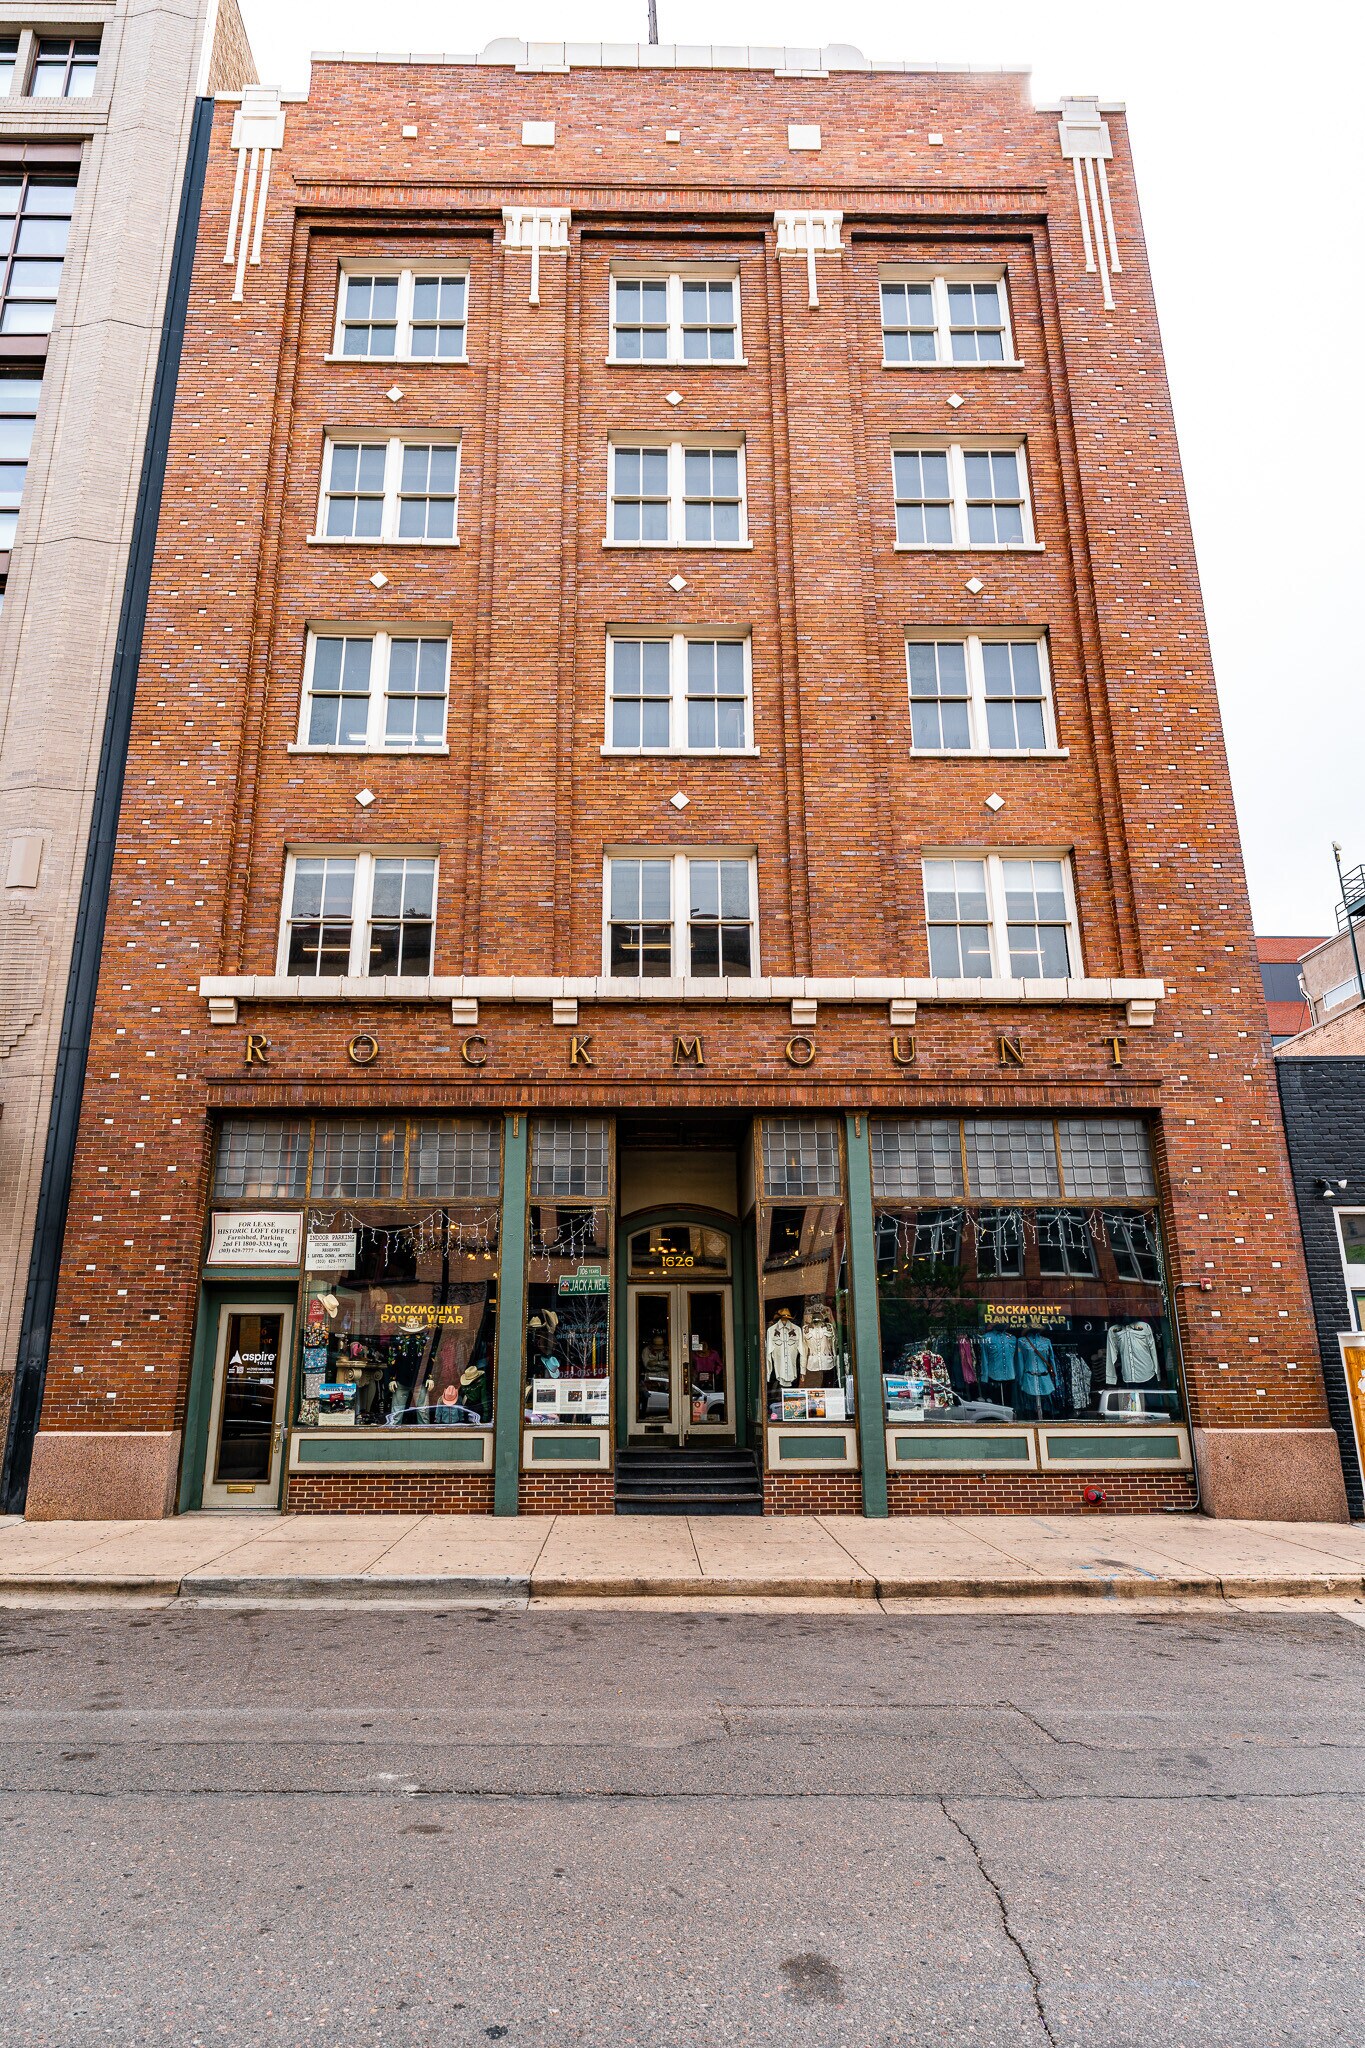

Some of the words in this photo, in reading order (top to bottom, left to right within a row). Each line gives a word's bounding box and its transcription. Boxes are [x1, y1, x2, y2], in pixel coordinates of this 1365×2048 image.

[245, 1033, 1127, 1068] ROCKMOUNT
[661, 1256, 694, 1267] 1626
[569, 1279, 588, 1291] JACK
[594, 1278, 606, 1291] WEIL
[384, 1303, 461, 1314] ROCKMOUNT
[986, 1304, 1062, 1315] ROCKMOUNT
[380, 1313, 423, 1323] RANCH
[427, 1314, 464, 1323] WEAR
[984, 1314, 1026, 1324] RANCH
[1029, 1314, 1066, 1324] WEAR
[241, 1351, 276, 1364] aspire
